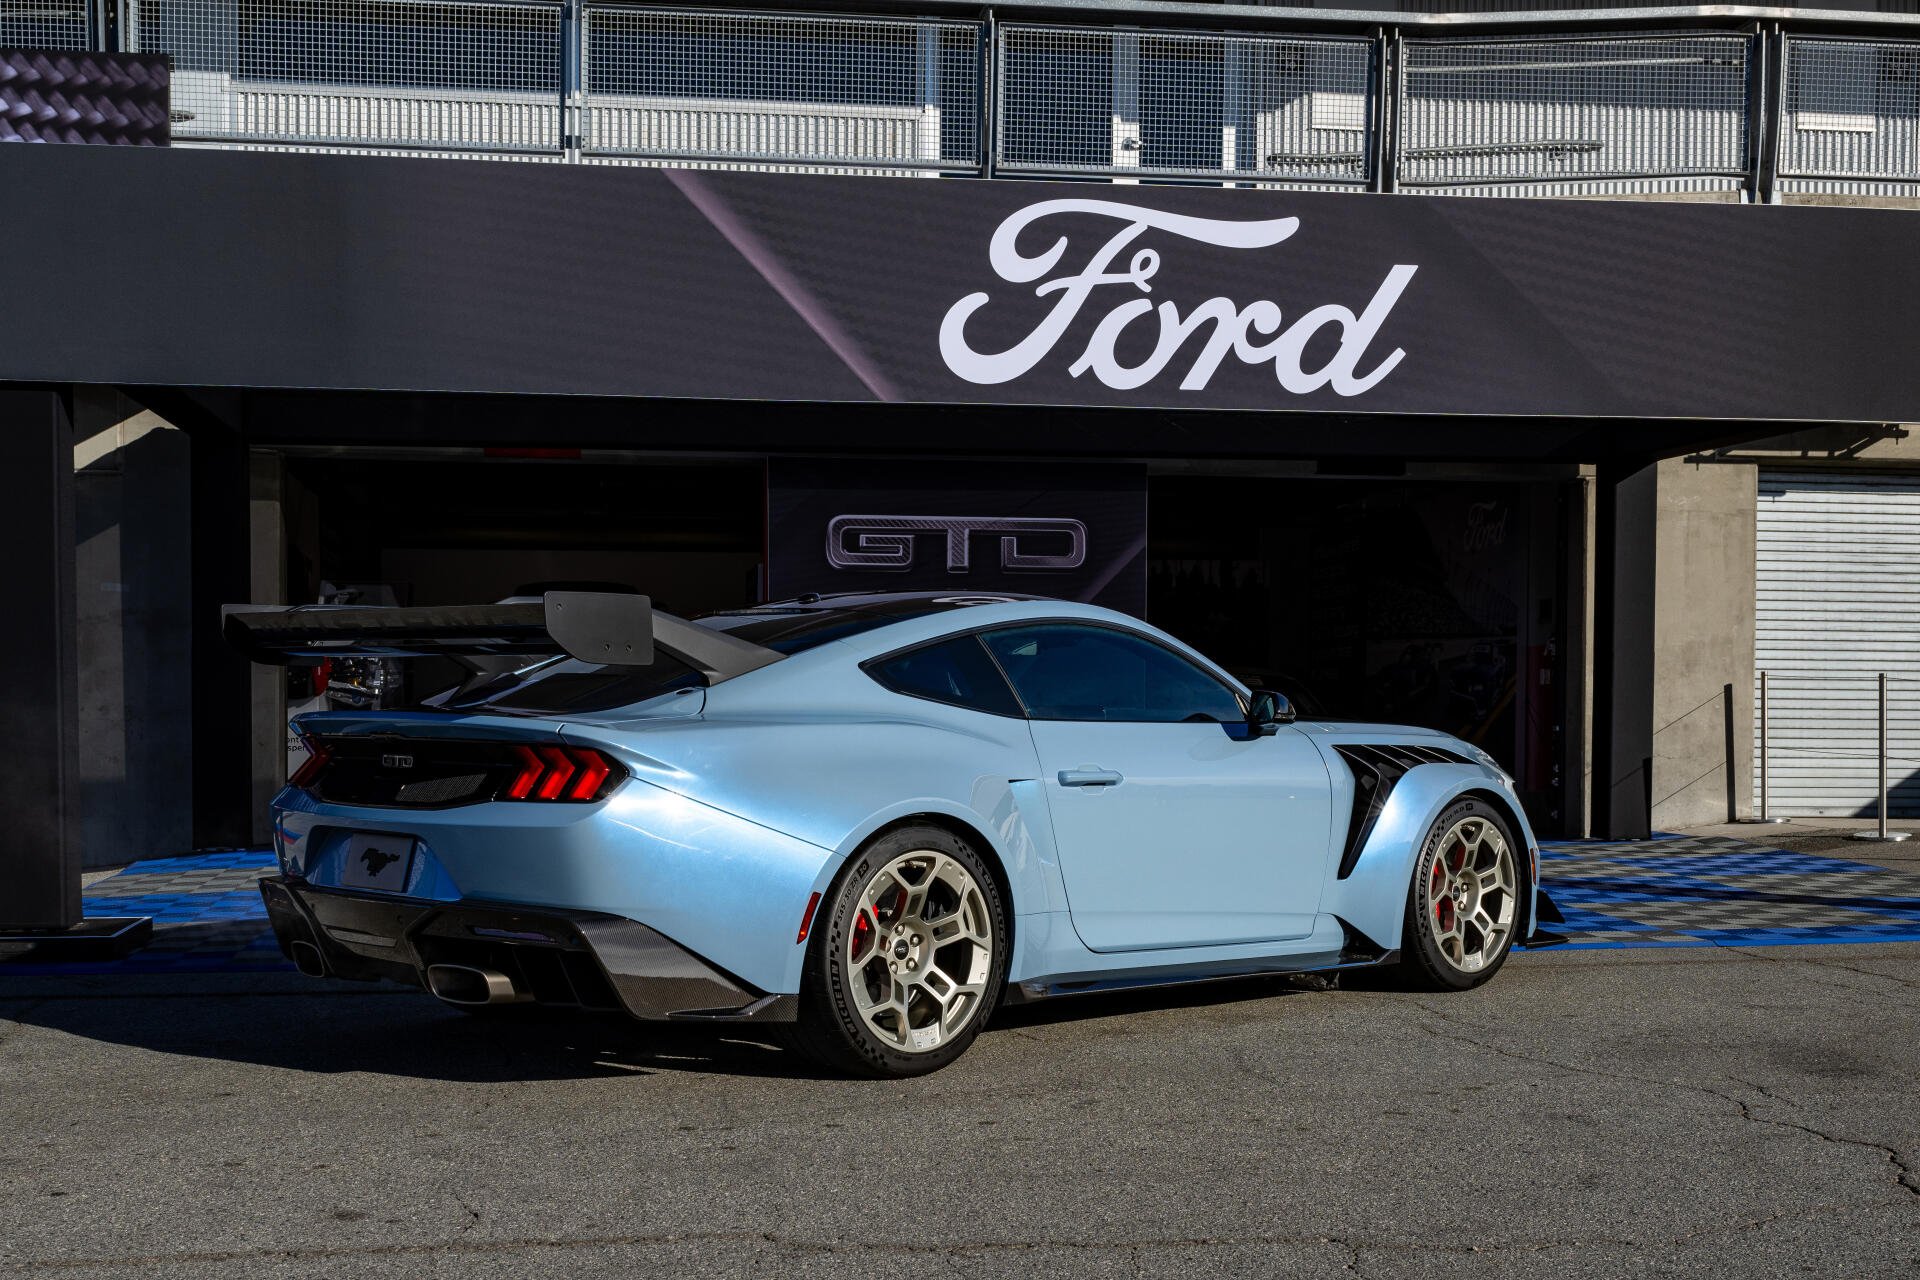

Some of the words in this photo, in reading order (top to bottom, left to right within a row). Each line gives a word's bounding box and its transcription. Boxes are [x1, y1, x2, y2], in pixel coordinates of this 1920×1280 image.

[939, 199, 1418, 396] Ford
[826, 514, 1088, 573] GTD
[382, 754, 414, 767] GTD
[831, 962, 857, 1034] MICHELIN
